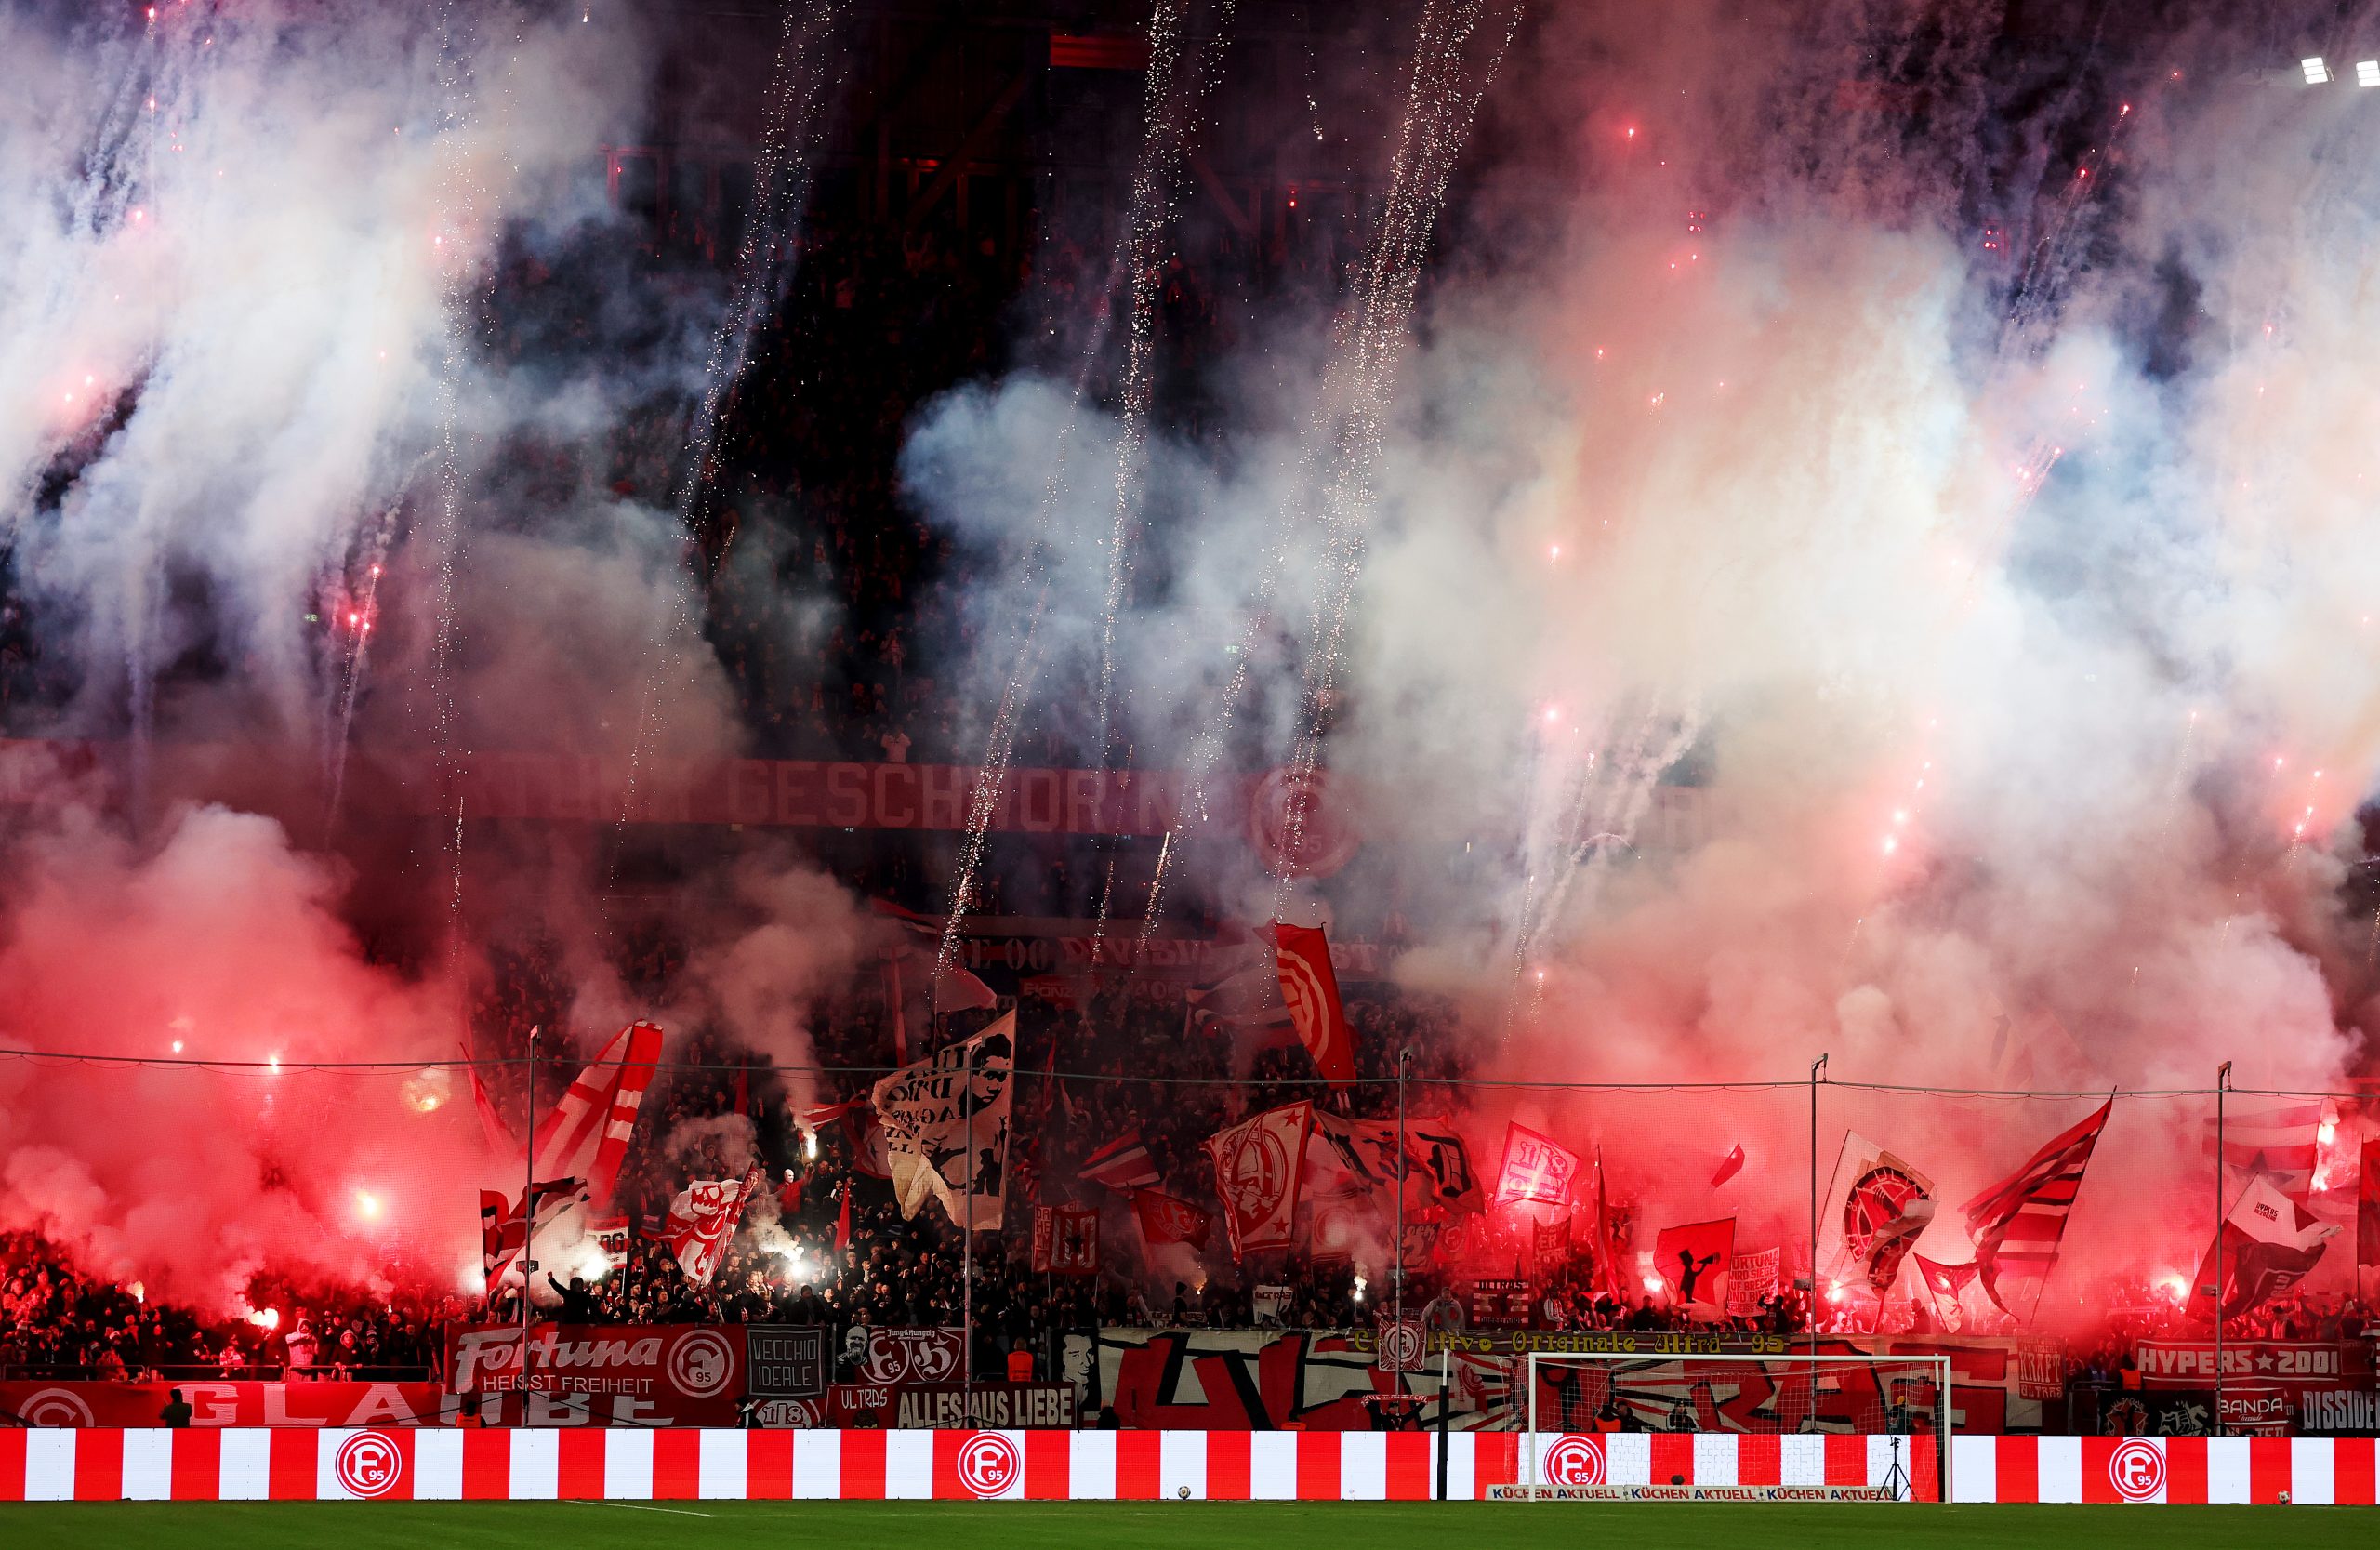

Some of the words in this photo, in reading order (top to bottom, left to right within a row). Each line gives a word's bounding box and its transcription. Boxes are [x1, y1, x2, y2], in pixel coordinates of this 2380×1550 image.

[752, 1338, 816, 1361] VECCHIO
[1512, 1331, 1636, 1353] Originale
[1752, 1334, 1785, 1354] 95
[455, 1327, 664, 1394] Fortuna
[887, 1360, 901, 1374] 95
[2138, 1348, 2253, 1373] HYPERS
[2278, 1350, 2338, 1374] 2001
[483, 1375, 556, 1391] HEISST
[562, 1377, 654, 1394] FREIHEIT
[695, 1371, 712, 1383] 95
[758, 1366, 813, 1387] IDEALE
[841, 1386, 888, 1409] ULTRAS
[2220, 1398, 2283, 1413] BANDA
[898, 1392, 963, 1429] ALLES
[971, 1391, 1010, 1428] AUS
[1019, 1388, 1072, 1426] LIEBE
[368, 1470, 385, 1481] 95
[988, 1470, 1003, 1481] 95
[1574, 1472, 1589, 1483] 95
[2138, 1475, 2152, 1486] 95
[1557, 1489, 1620, 1499] AKTUELL
[1631, 1488, 1690, 1499] KÜCHEN
[1694, 1489, 1756, 1500] AKTUELL
[1767, 1488, 1826, 1500] KÜCHEN
[1831, 1489, 1891, 1501] AKTUELL
